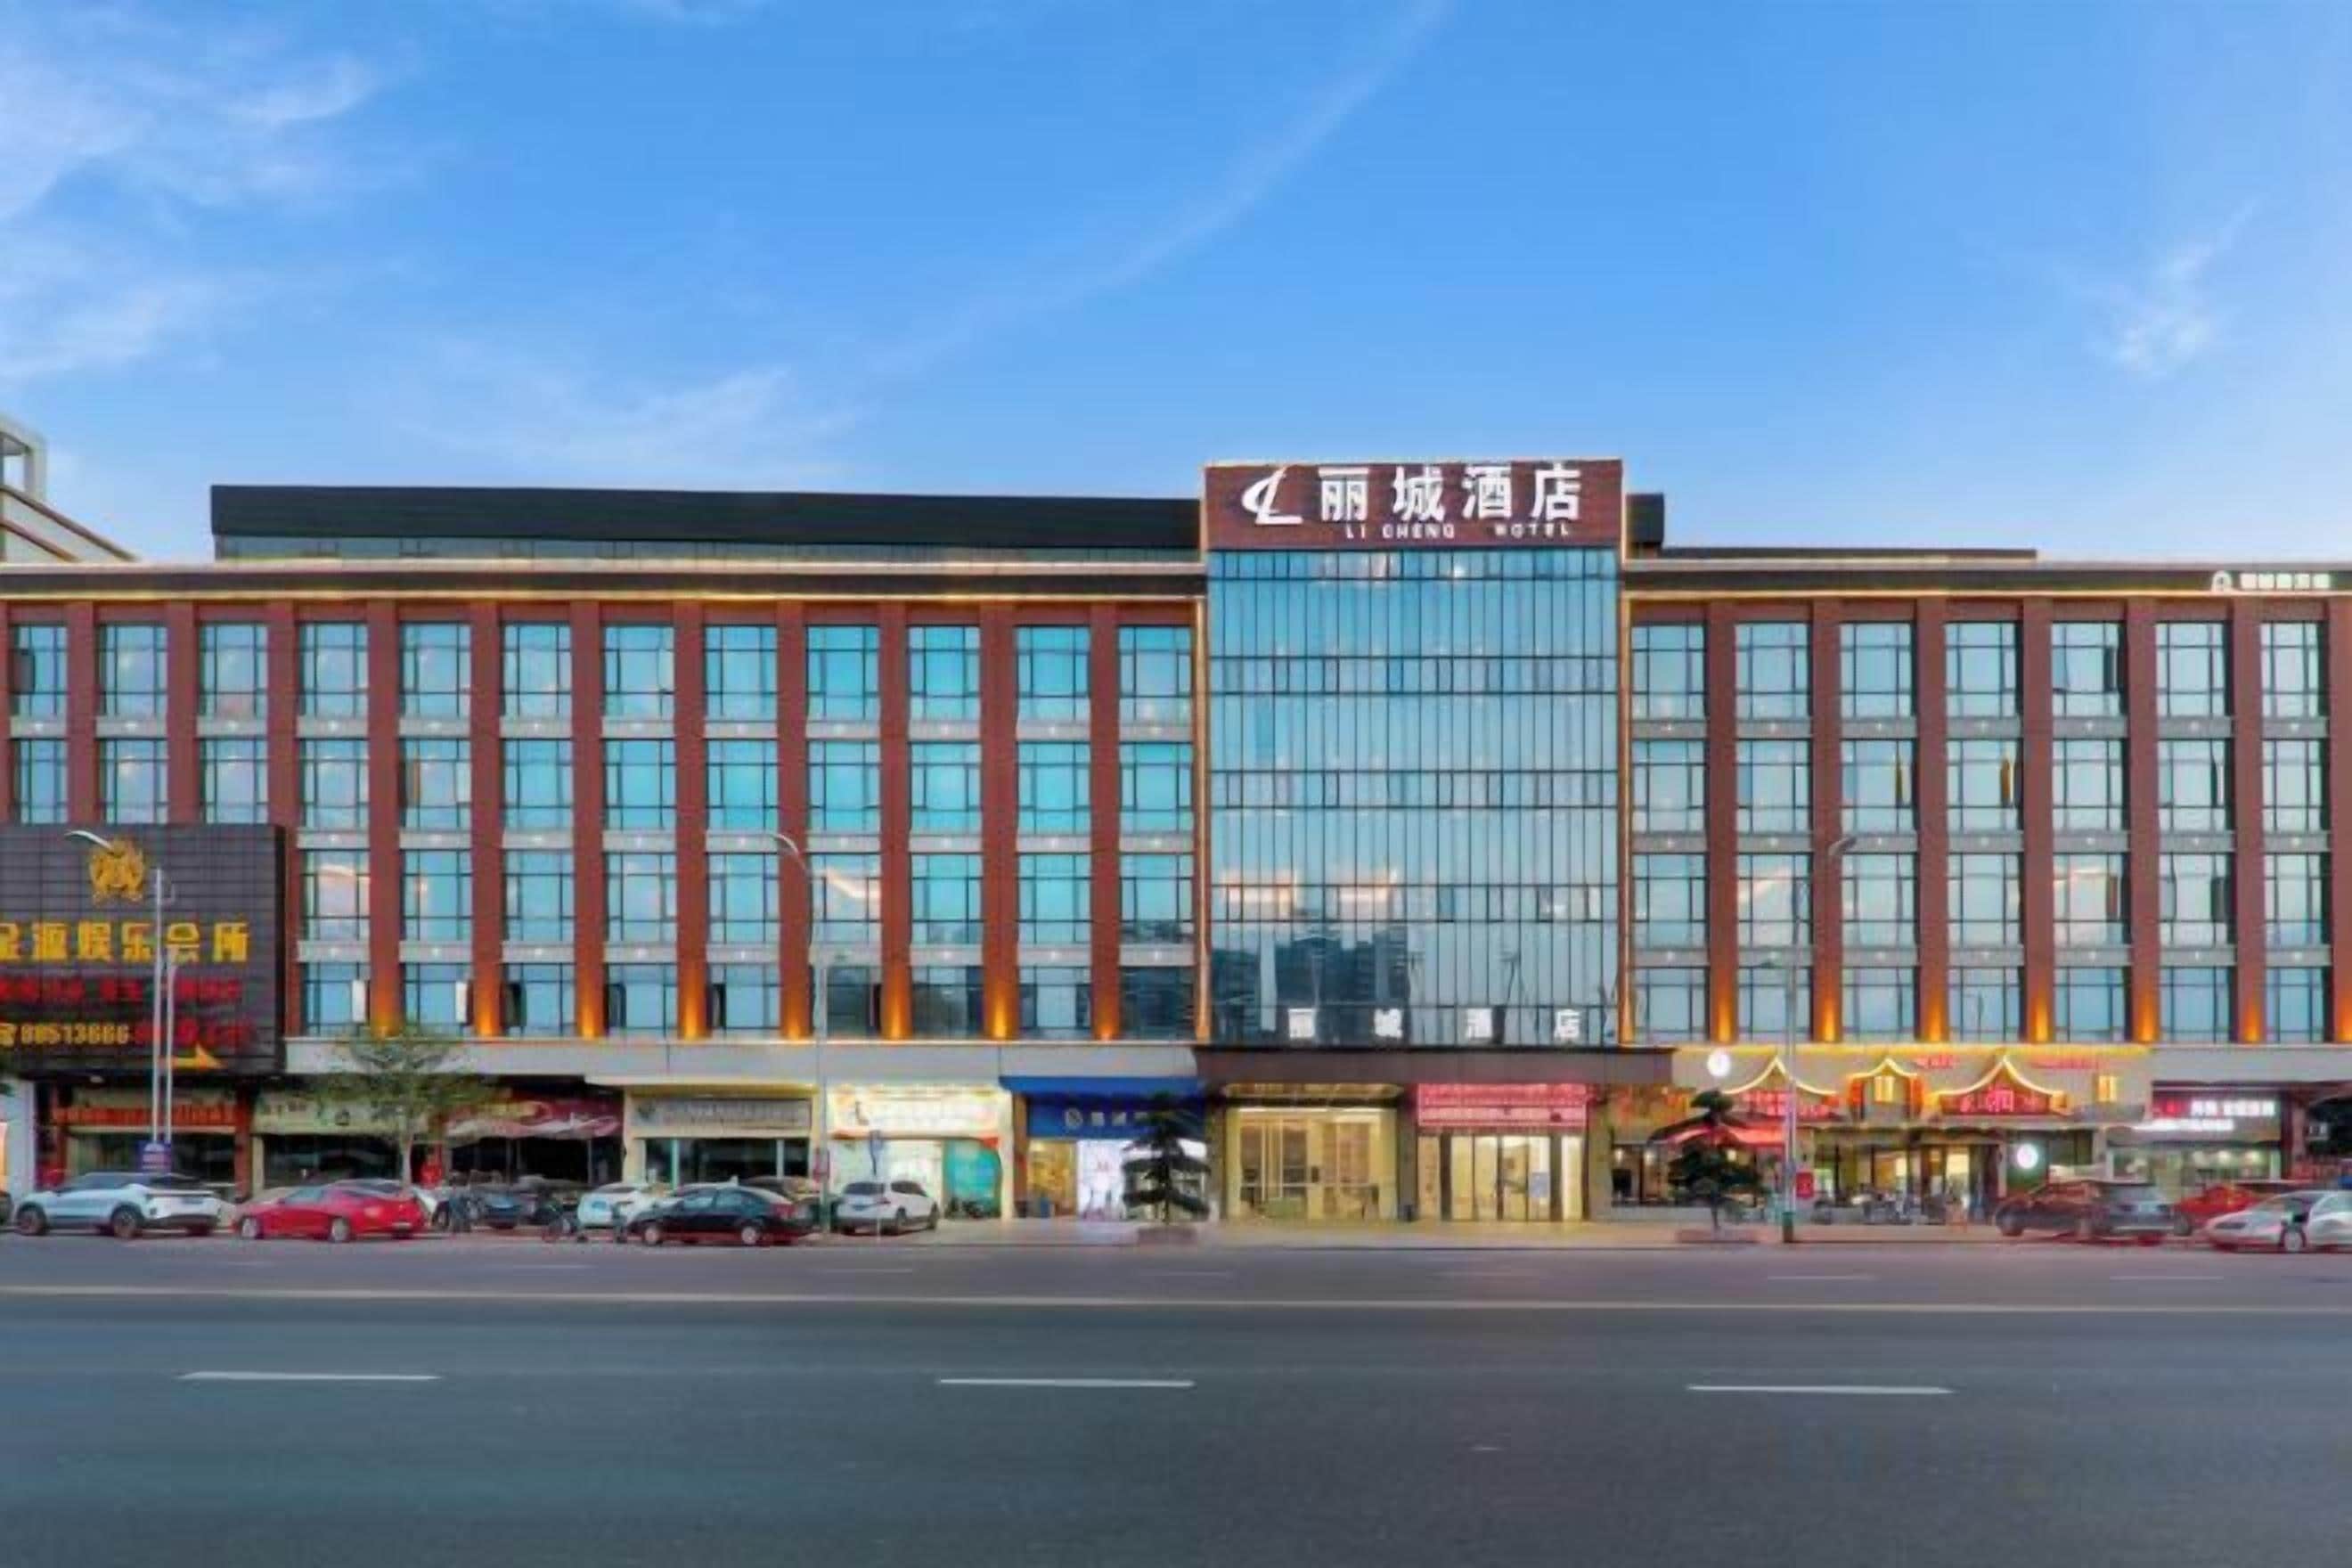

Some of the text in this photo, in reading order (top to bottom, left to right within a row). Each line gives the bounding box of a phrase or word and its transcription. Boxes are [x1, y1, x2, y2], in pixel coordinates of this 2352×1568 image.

[1318, 462, 1580, 521] 丽城酒店
[1345, 522, 1569, 540] LI CHENG HOTEL
